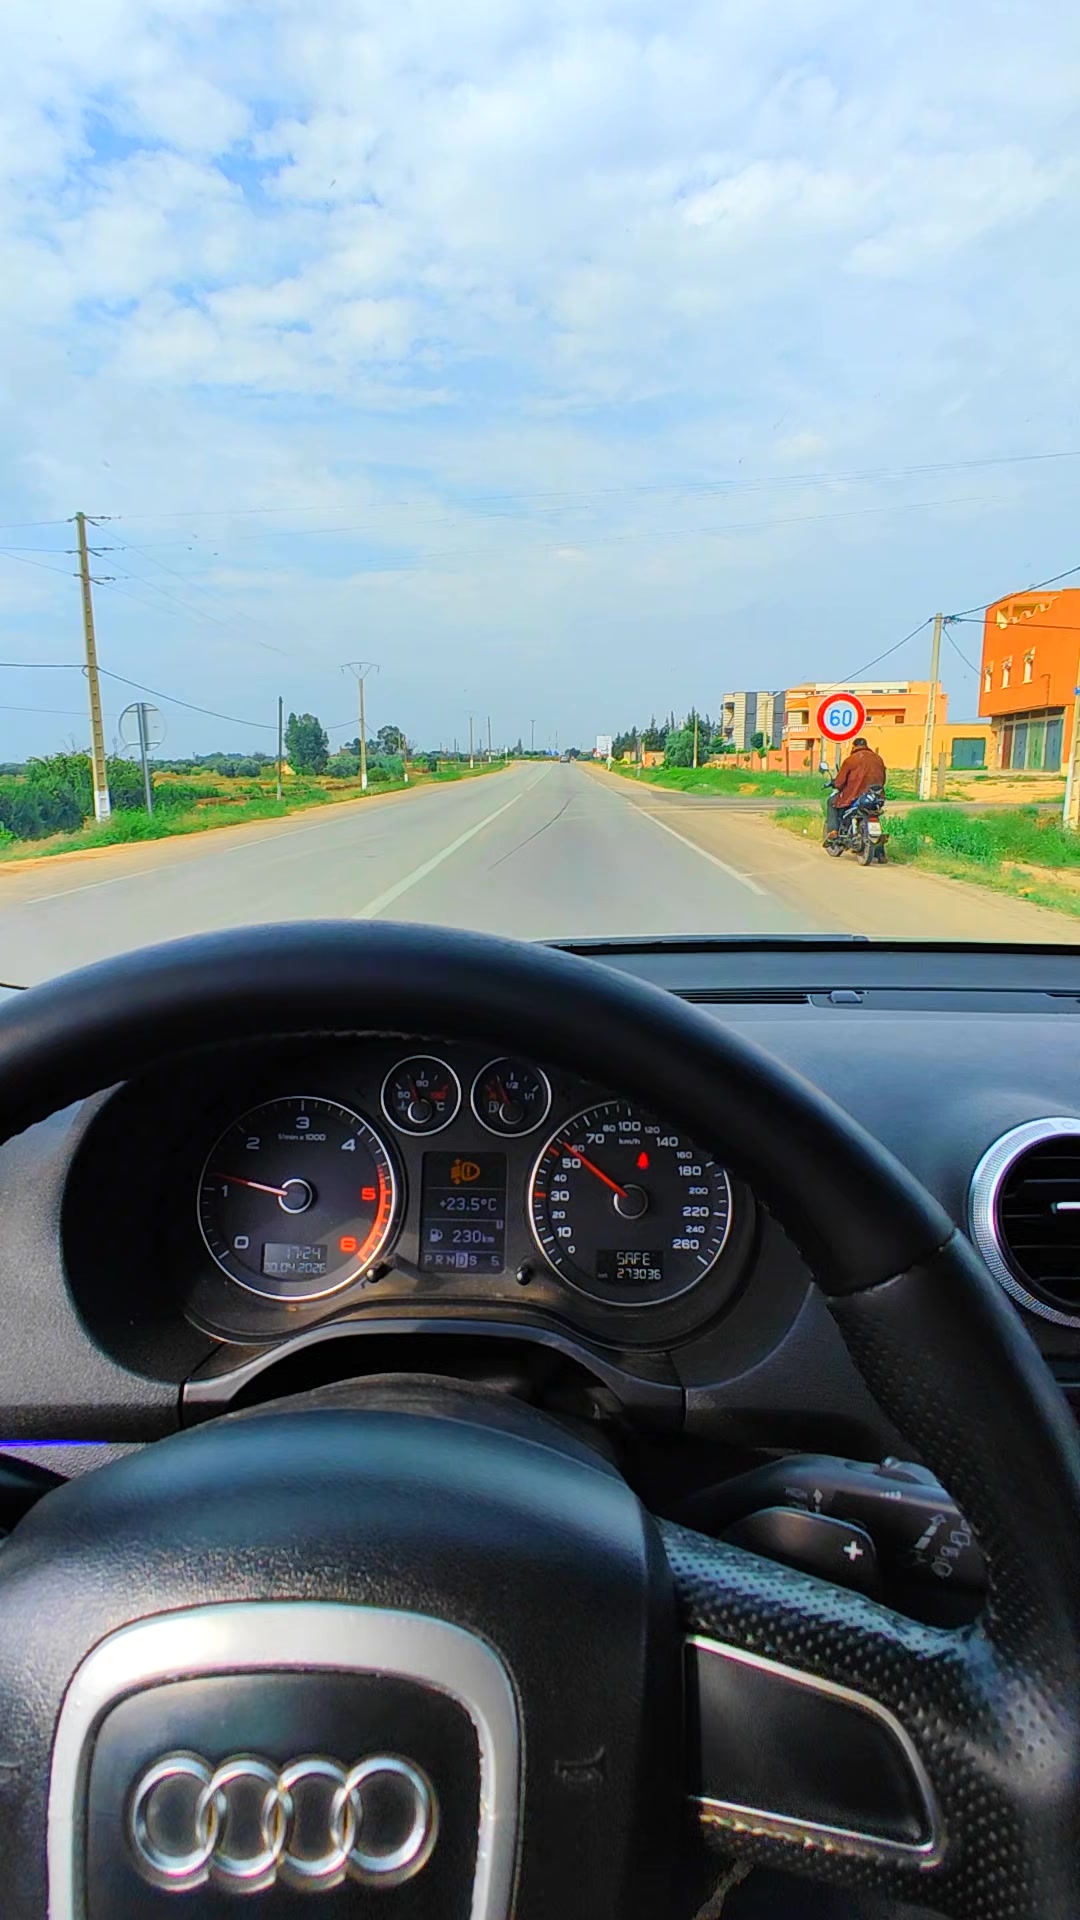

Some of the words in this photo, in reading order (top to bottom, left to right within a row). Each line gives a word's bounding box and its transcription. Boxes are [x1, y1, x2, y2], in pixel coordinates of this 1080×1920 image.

[830, 709, 852, 727] 60
[296, 1116, 310, 1129] 3
[618, 1121, 641, 1132] 100
[644, 1126, 660, 1134] 120
[246, 1136, 260, 1150] 2
[341, 1138, 356, 1151] 4
[585, 1133, 605, 1144] 70
[656, 1136, 679, 1148] 140
[676, 1151, 693, 1159] 160
[561, 1157, 582, 1169] 50
[678, 1165, 702, 1177] 180
[553, 1173, 568, 1183] 40
[221, 1185, 229, 1198] 1
[361, 1187, 376, 1201] 5
[550, 1190, 570, 1202] 30
[688, 1186, 709, 1195] 200
[551, 1210, 566, 1219] 20
[682, 1206, 710, 1218] 220
[557, 1226, 572, 1238] 10
[685, 1225, 706, 1234] 240
[234, 1236, 249, 1249] 0
[340, 1237, 356, 1251] 6
[672, 1238, 700, 1250] 260
[567, 1245, 576, 1254] 0
[616, 1251, 650, 1266] SAFE
[616, 1267, 662, 1280] 273036
